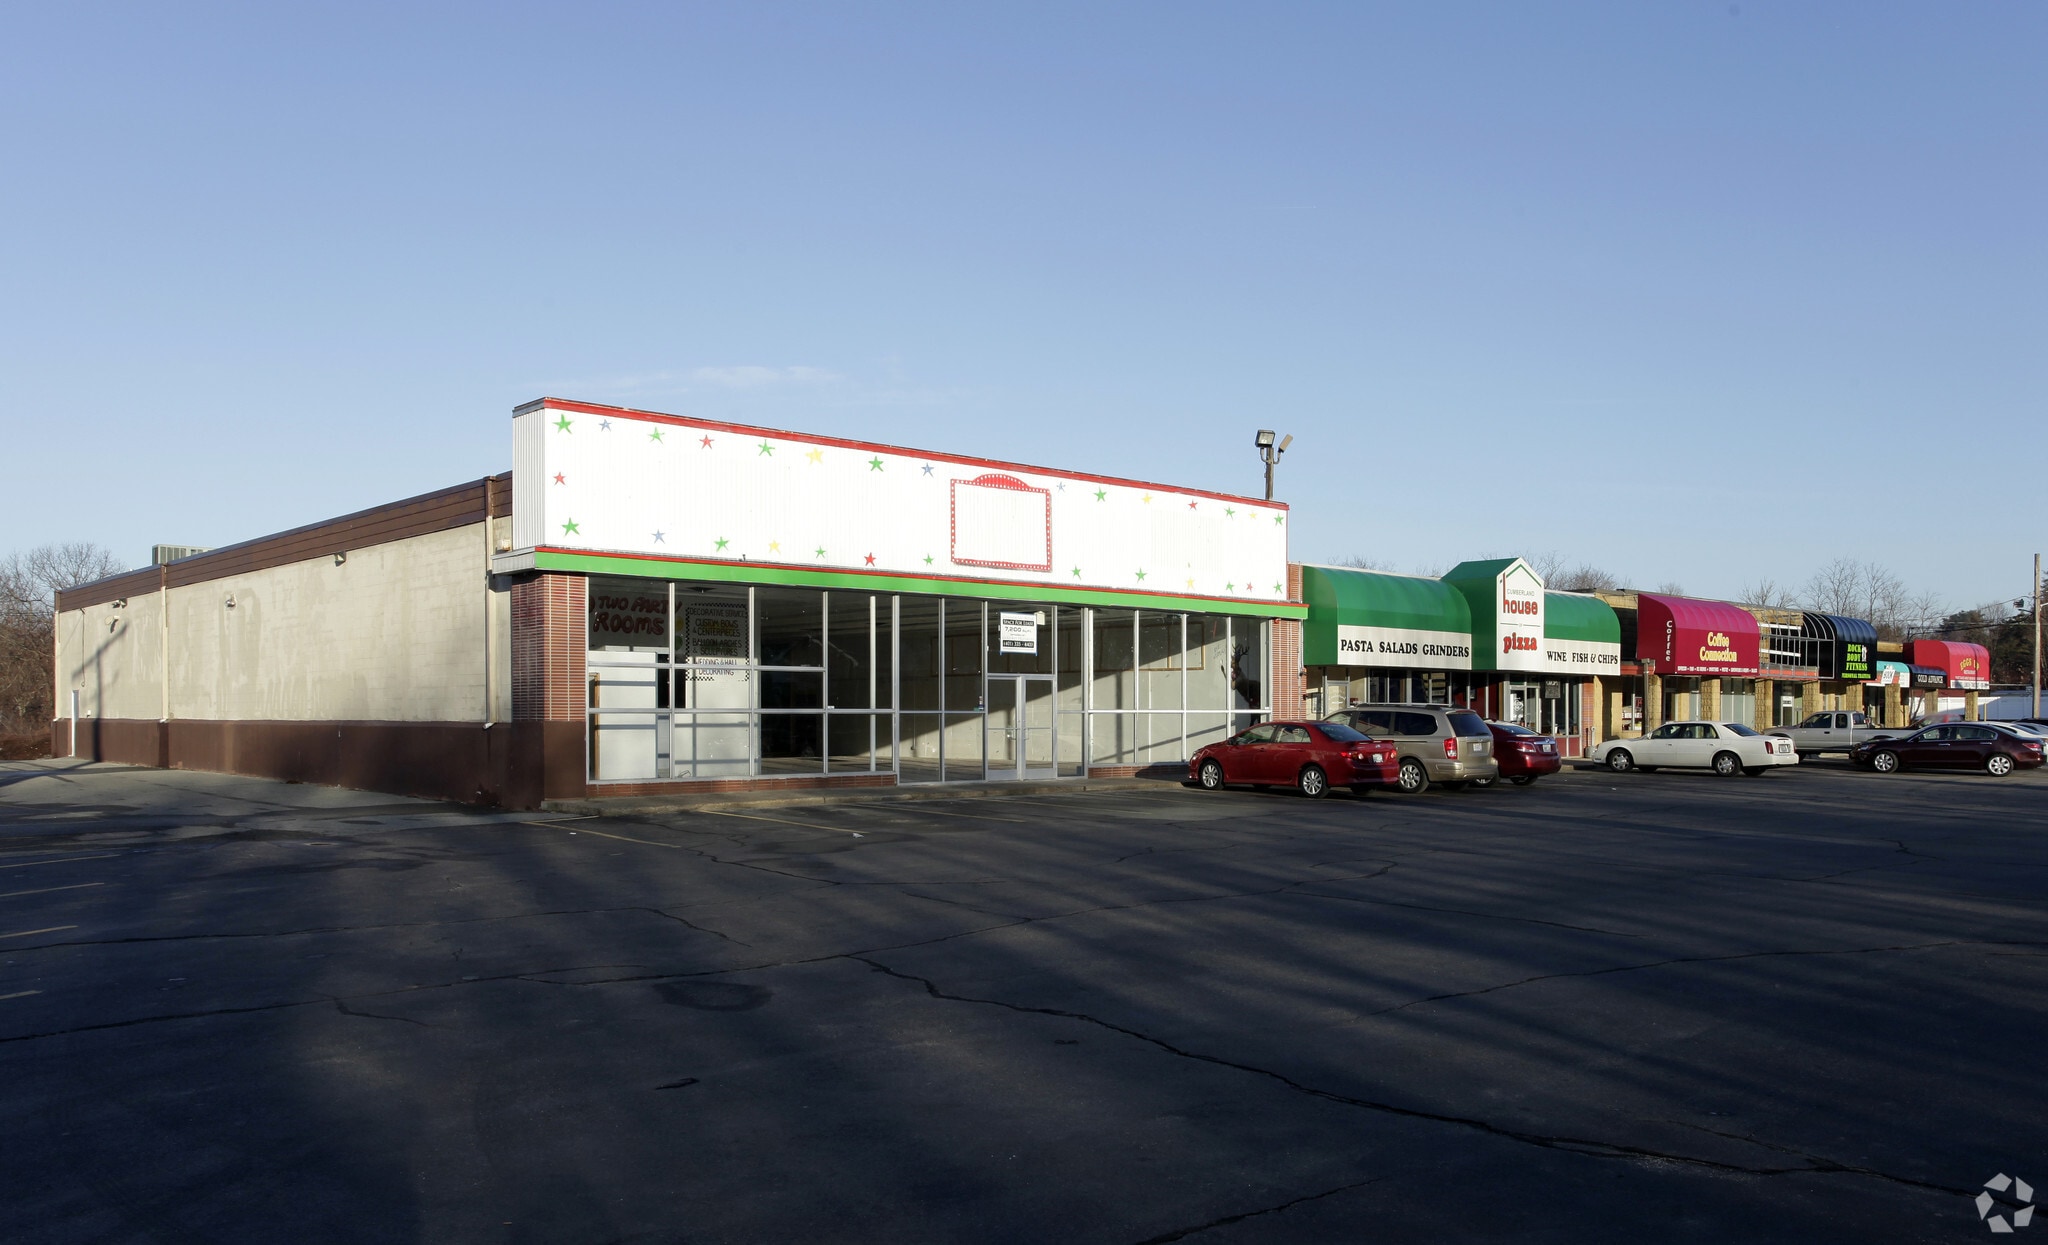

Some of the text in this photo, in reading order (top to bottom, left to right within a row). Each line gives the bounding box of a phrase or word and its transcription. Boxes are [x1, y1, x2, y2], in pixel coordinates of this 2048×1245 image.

[1506, 588, 1535, 597] CUMBERLAND
[598, 595, 628, 610] TWO
[593, 612, 664, 635] ROOMS
[1503, 632, 1537, 654] pizza
[1707, 631, 1730, 648] Coffee
[1340, 639, 1469, 658] PASTA SALADS GRINDERS
[1699, 646, 1737, 662] Connection
[1547, 651, 1618, 664] WINE FISH & CHIPS
[1846, 653, 1861, 662] BODY
[1845, 662, 1868, 671] FITNESS
